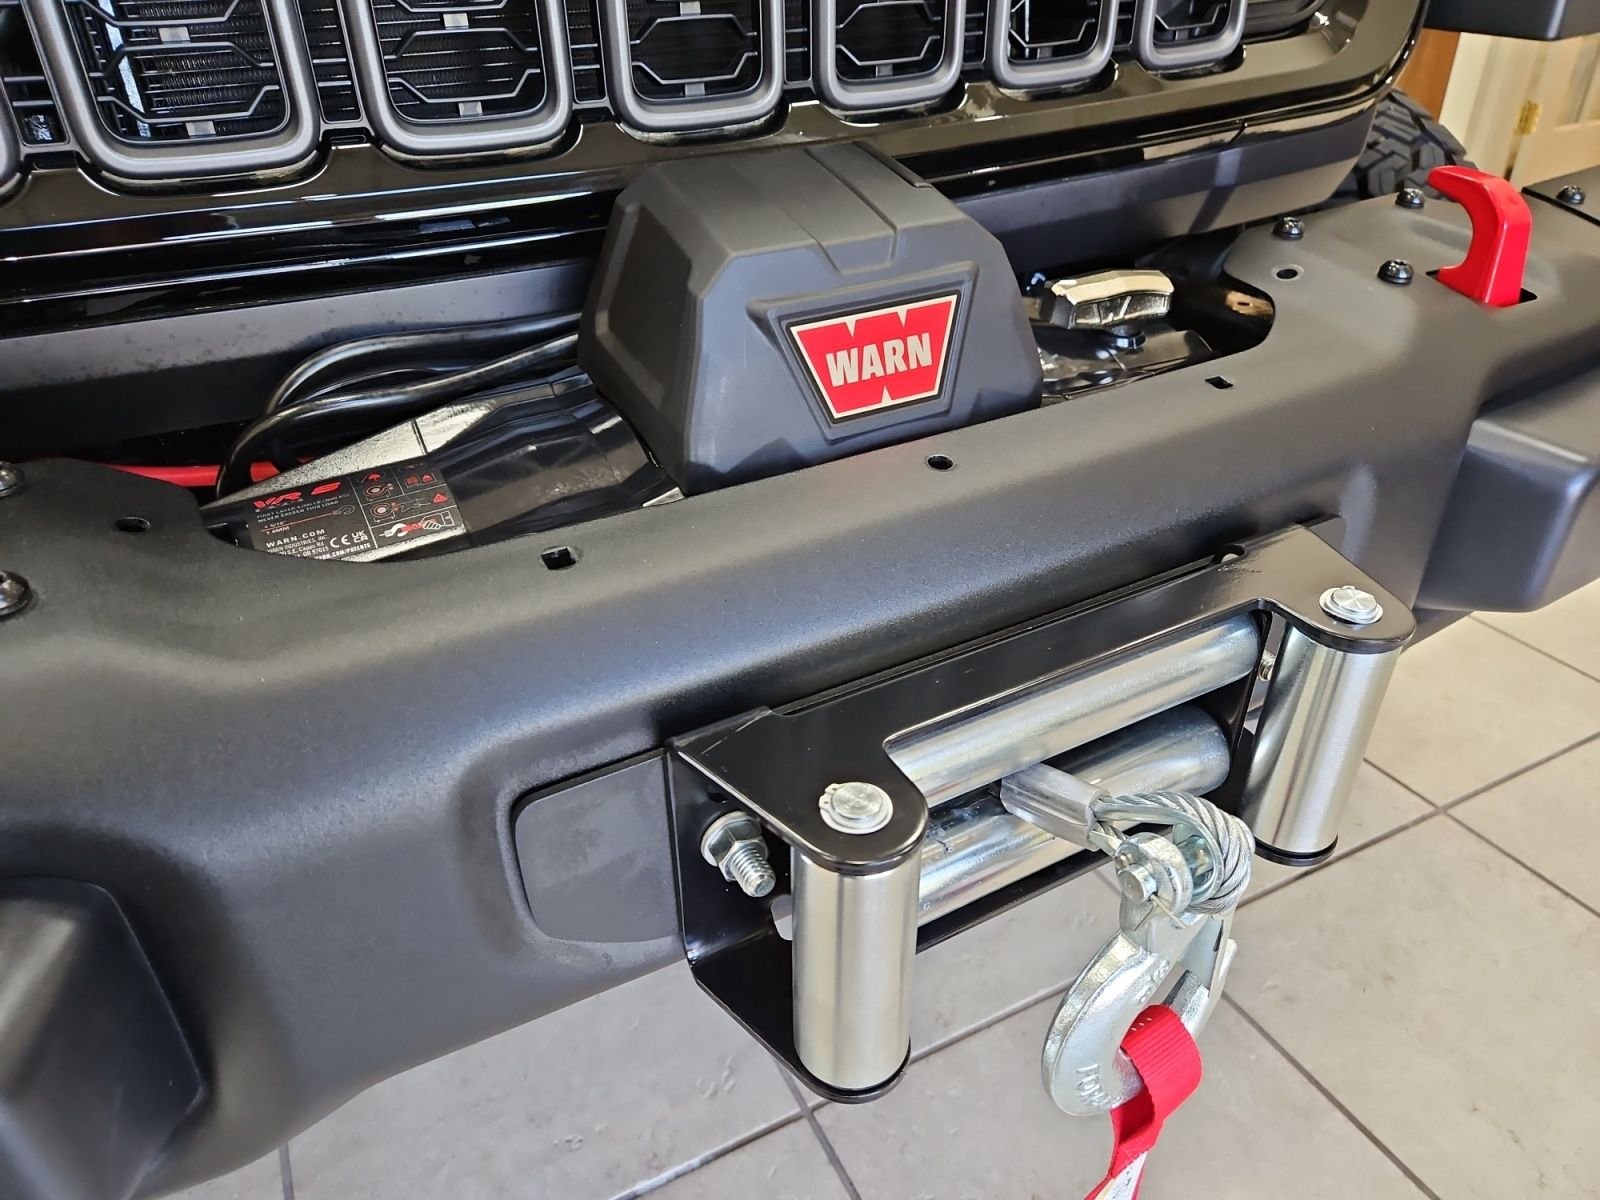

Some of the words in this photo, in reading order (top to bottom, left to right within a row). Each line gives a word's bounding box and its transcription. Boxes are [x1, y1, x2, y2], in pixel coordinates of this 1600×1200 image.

[825, 332, 933, 388] WARN
[257, 515, 279, 523] NEVER
[321, 500, 339, 508] LOAD
[265, 529, 325, 548] WARN.COM
[329, 534, 351, 548] CE
